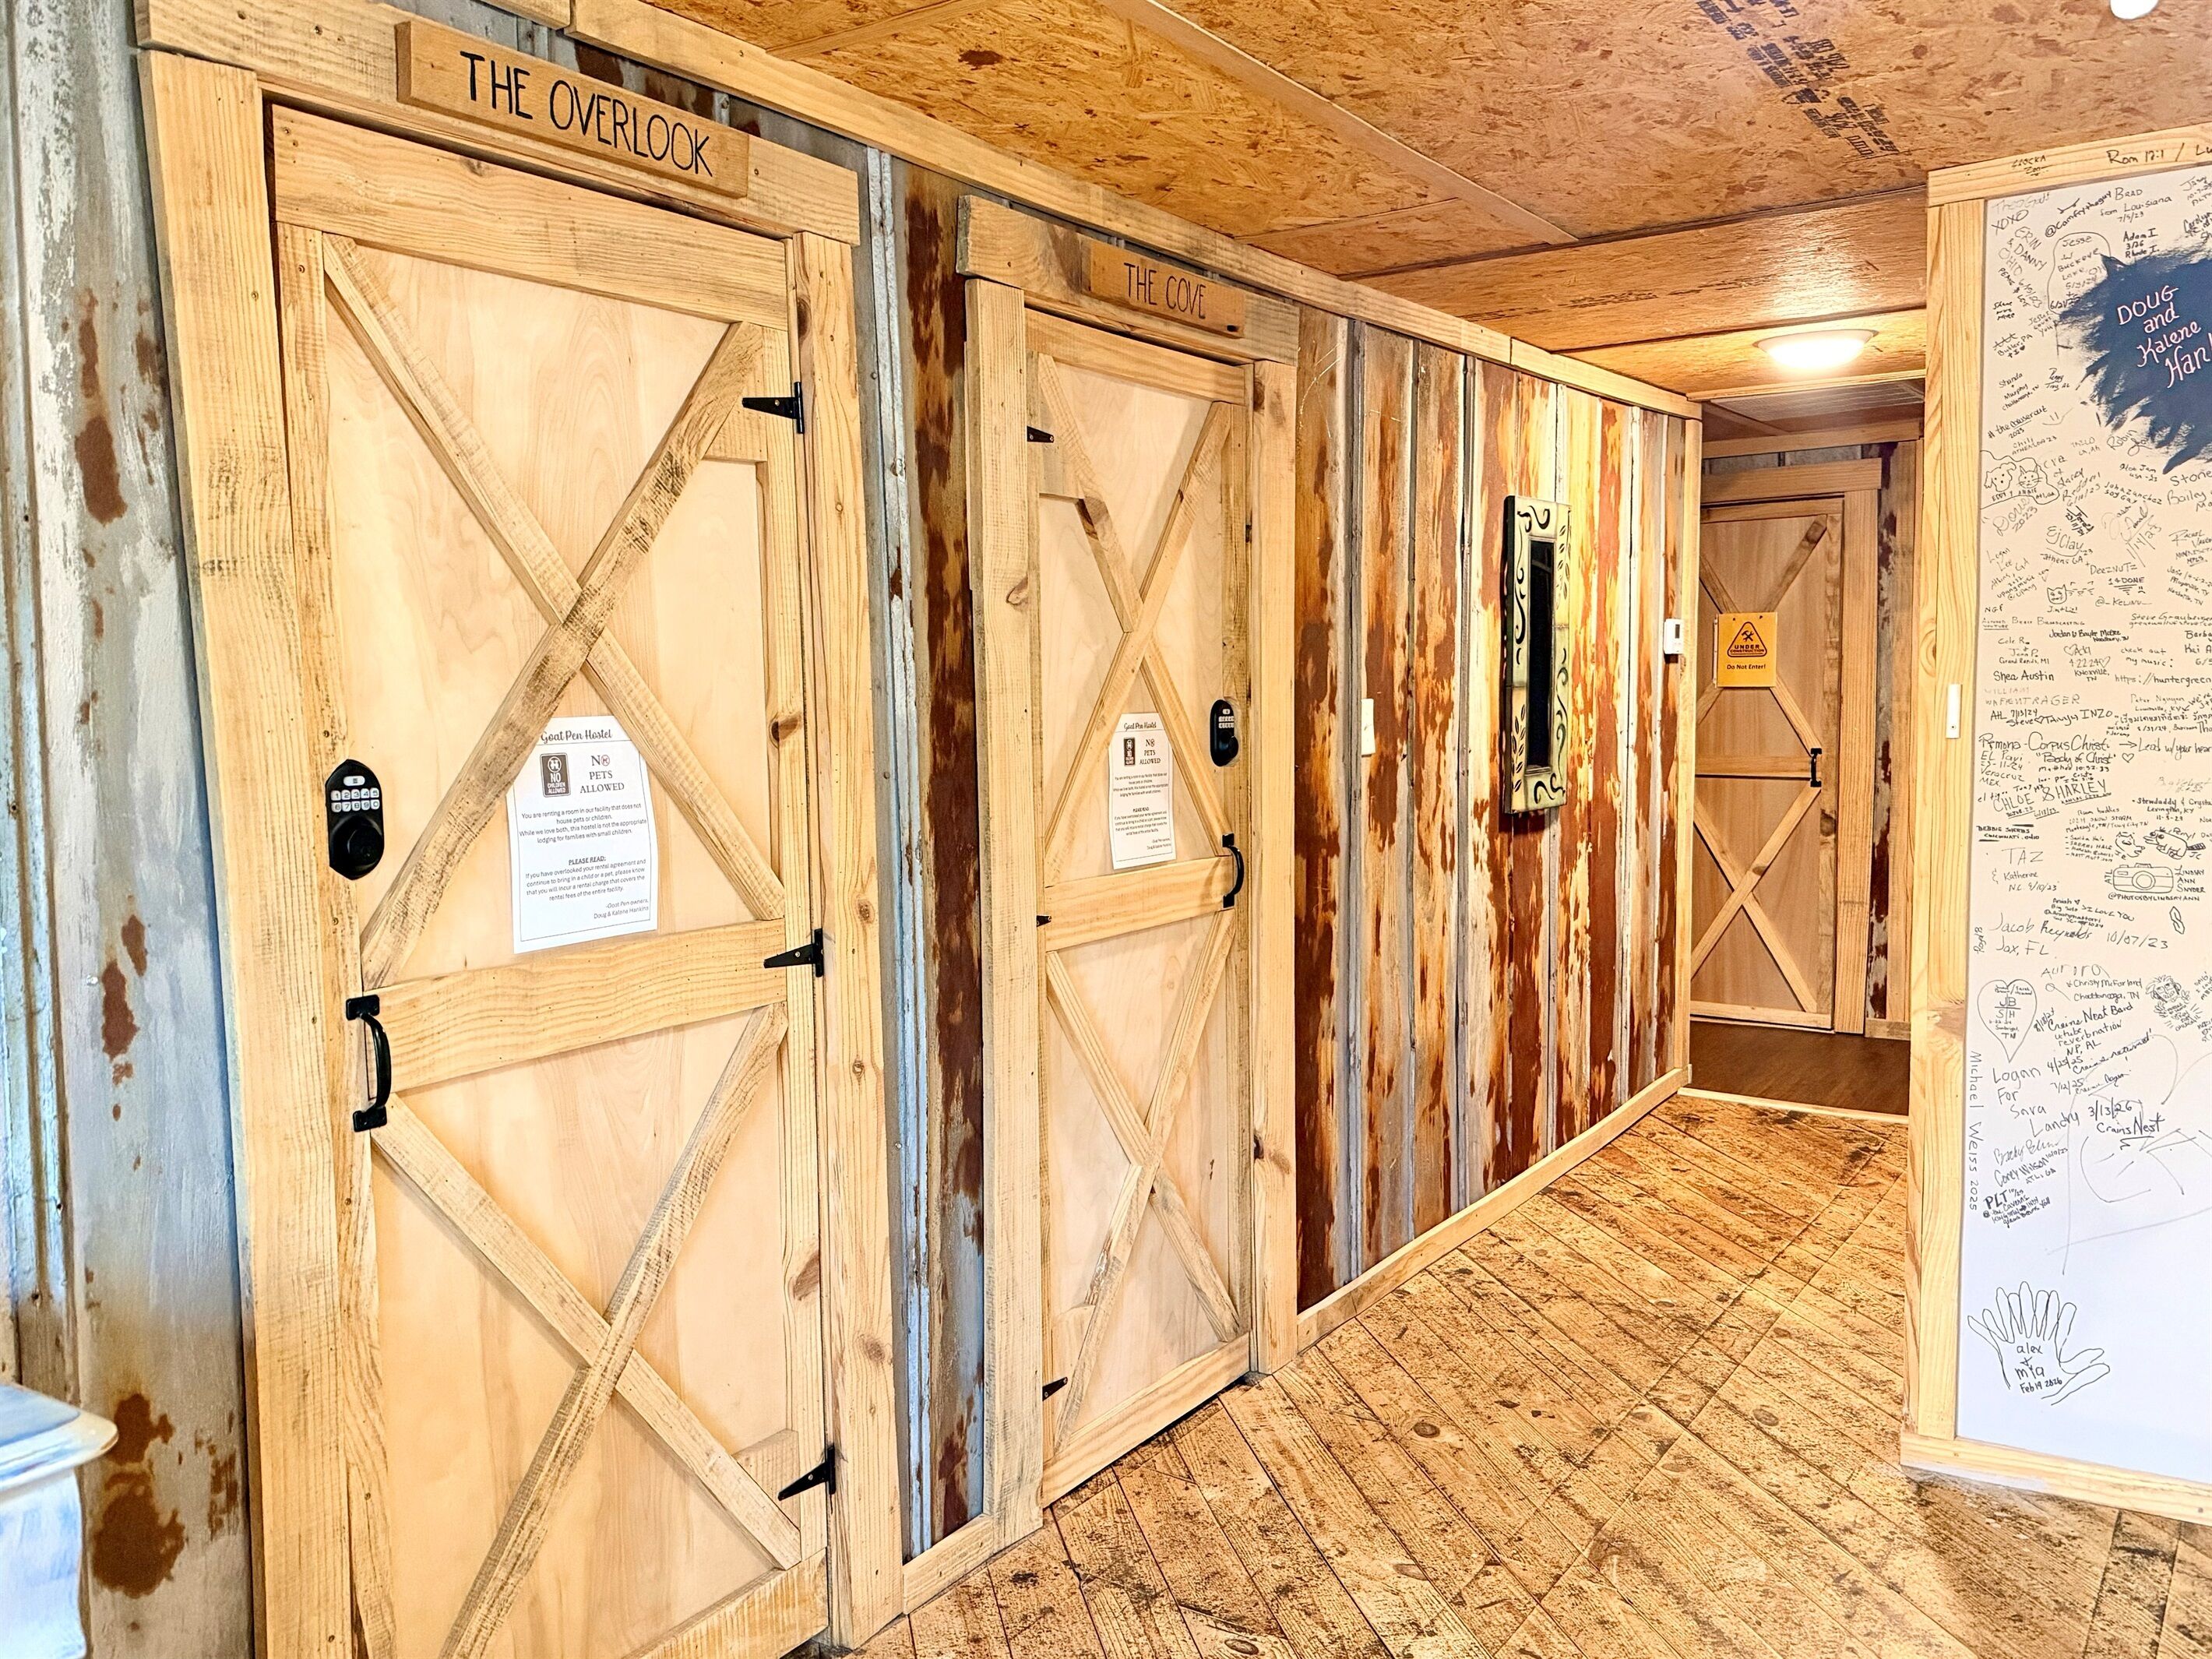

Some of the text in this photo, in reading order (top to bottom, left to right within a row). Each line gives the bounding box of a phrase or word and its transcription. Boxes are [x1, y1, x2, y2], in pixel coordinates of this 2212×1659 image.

[460, 50, 713, 177] THE OVERLOOK
[2123, 231, 2147, 242] Adam
[2014, 244, 2047, 270] DANNY
[1124, 262, 1206, 319] THE COVE
[2117, 285, 2179, 326] DOUG
[2143, 301, 2180, 333] and
[2136, 321, 2202, 367] Kalene
[2164, 333, 2212, 389] Han
[1993, 670, 2055, 683] Shea Austin
[541, 729, 612, 744] Goat Pen Hostel
[2028, 731, 2110, 752] Corpus Christi
[551, 773, 561, 783] NO
[589, 770, 612, 780] PETS
[580, 783, 625, 793] ALLOWED
[1993, 779, 2107, 812] CHLOE HARLEY
[2002, 847, 2044, 865] TAZ
[1989, 912, 2034, 933] Jacob
[2025, 940, 2048, 955] FL
[1969, 1051, 1985, 1108] Michael
[1993, 1067, 2041, 1090] Logan
[1998, 1087, 2019, 1104] For
[1969, 1180, 1978, 1210] 2025
[1983, 1190, 2008, 1210] PLT
[2016, 1342, 2043, 1354] alex
[2020, 1384, 2035, 1394] Feb
